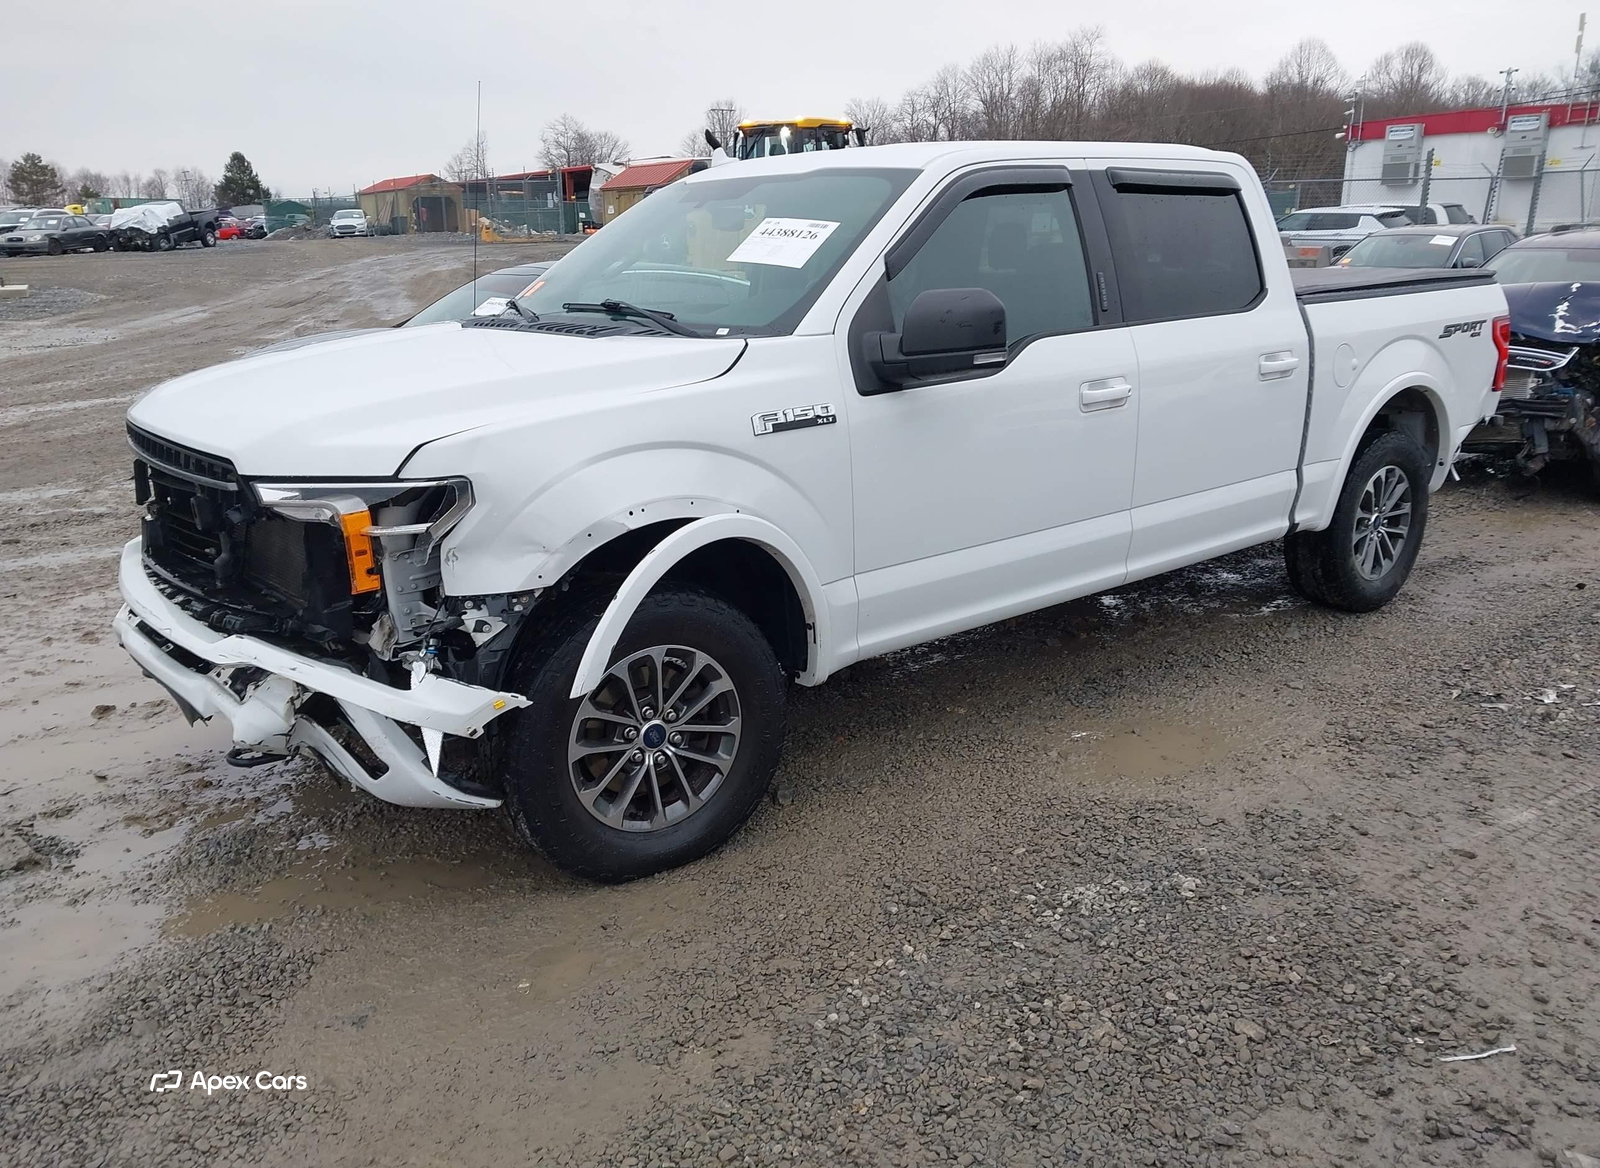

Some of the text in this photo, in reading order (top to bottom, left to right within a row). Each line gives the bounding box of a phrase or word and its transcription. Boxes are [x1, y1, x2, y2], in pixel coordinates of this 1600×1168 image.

[760, 228, 820, 240] 44388126
[1438, 320, 1487, 339] SPORT
[750, 403, 836, 436] F150
[816, 416, 834, 425] XLT
